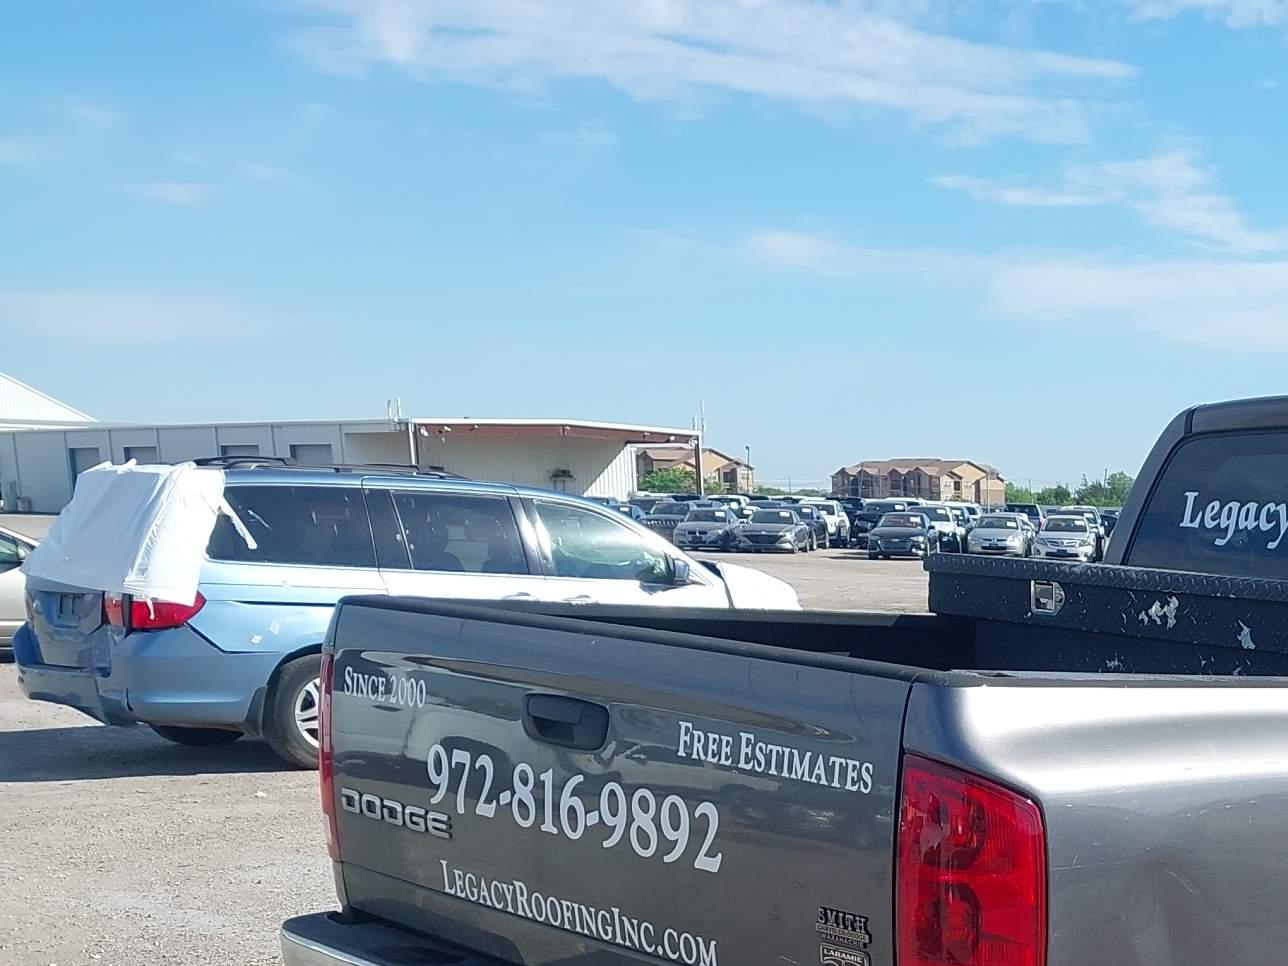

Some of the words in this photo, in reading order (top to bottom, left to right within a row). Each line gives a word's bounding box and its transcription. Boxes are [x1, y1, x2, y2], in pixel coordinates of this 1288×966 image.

[343, 666, 387, 698] SINCE
[388, 675, 427, 708] 2000
[677, 721, 732, 767] FREE
[738, 733, 874, 794] ESTIMATES
[340, 787, 453, 839] DODGE
[426, 743, 724, 873] 972-816-9892
[817, 907, 867, 934] SMITH
[823, 948, 863, 963] LARAMIE
